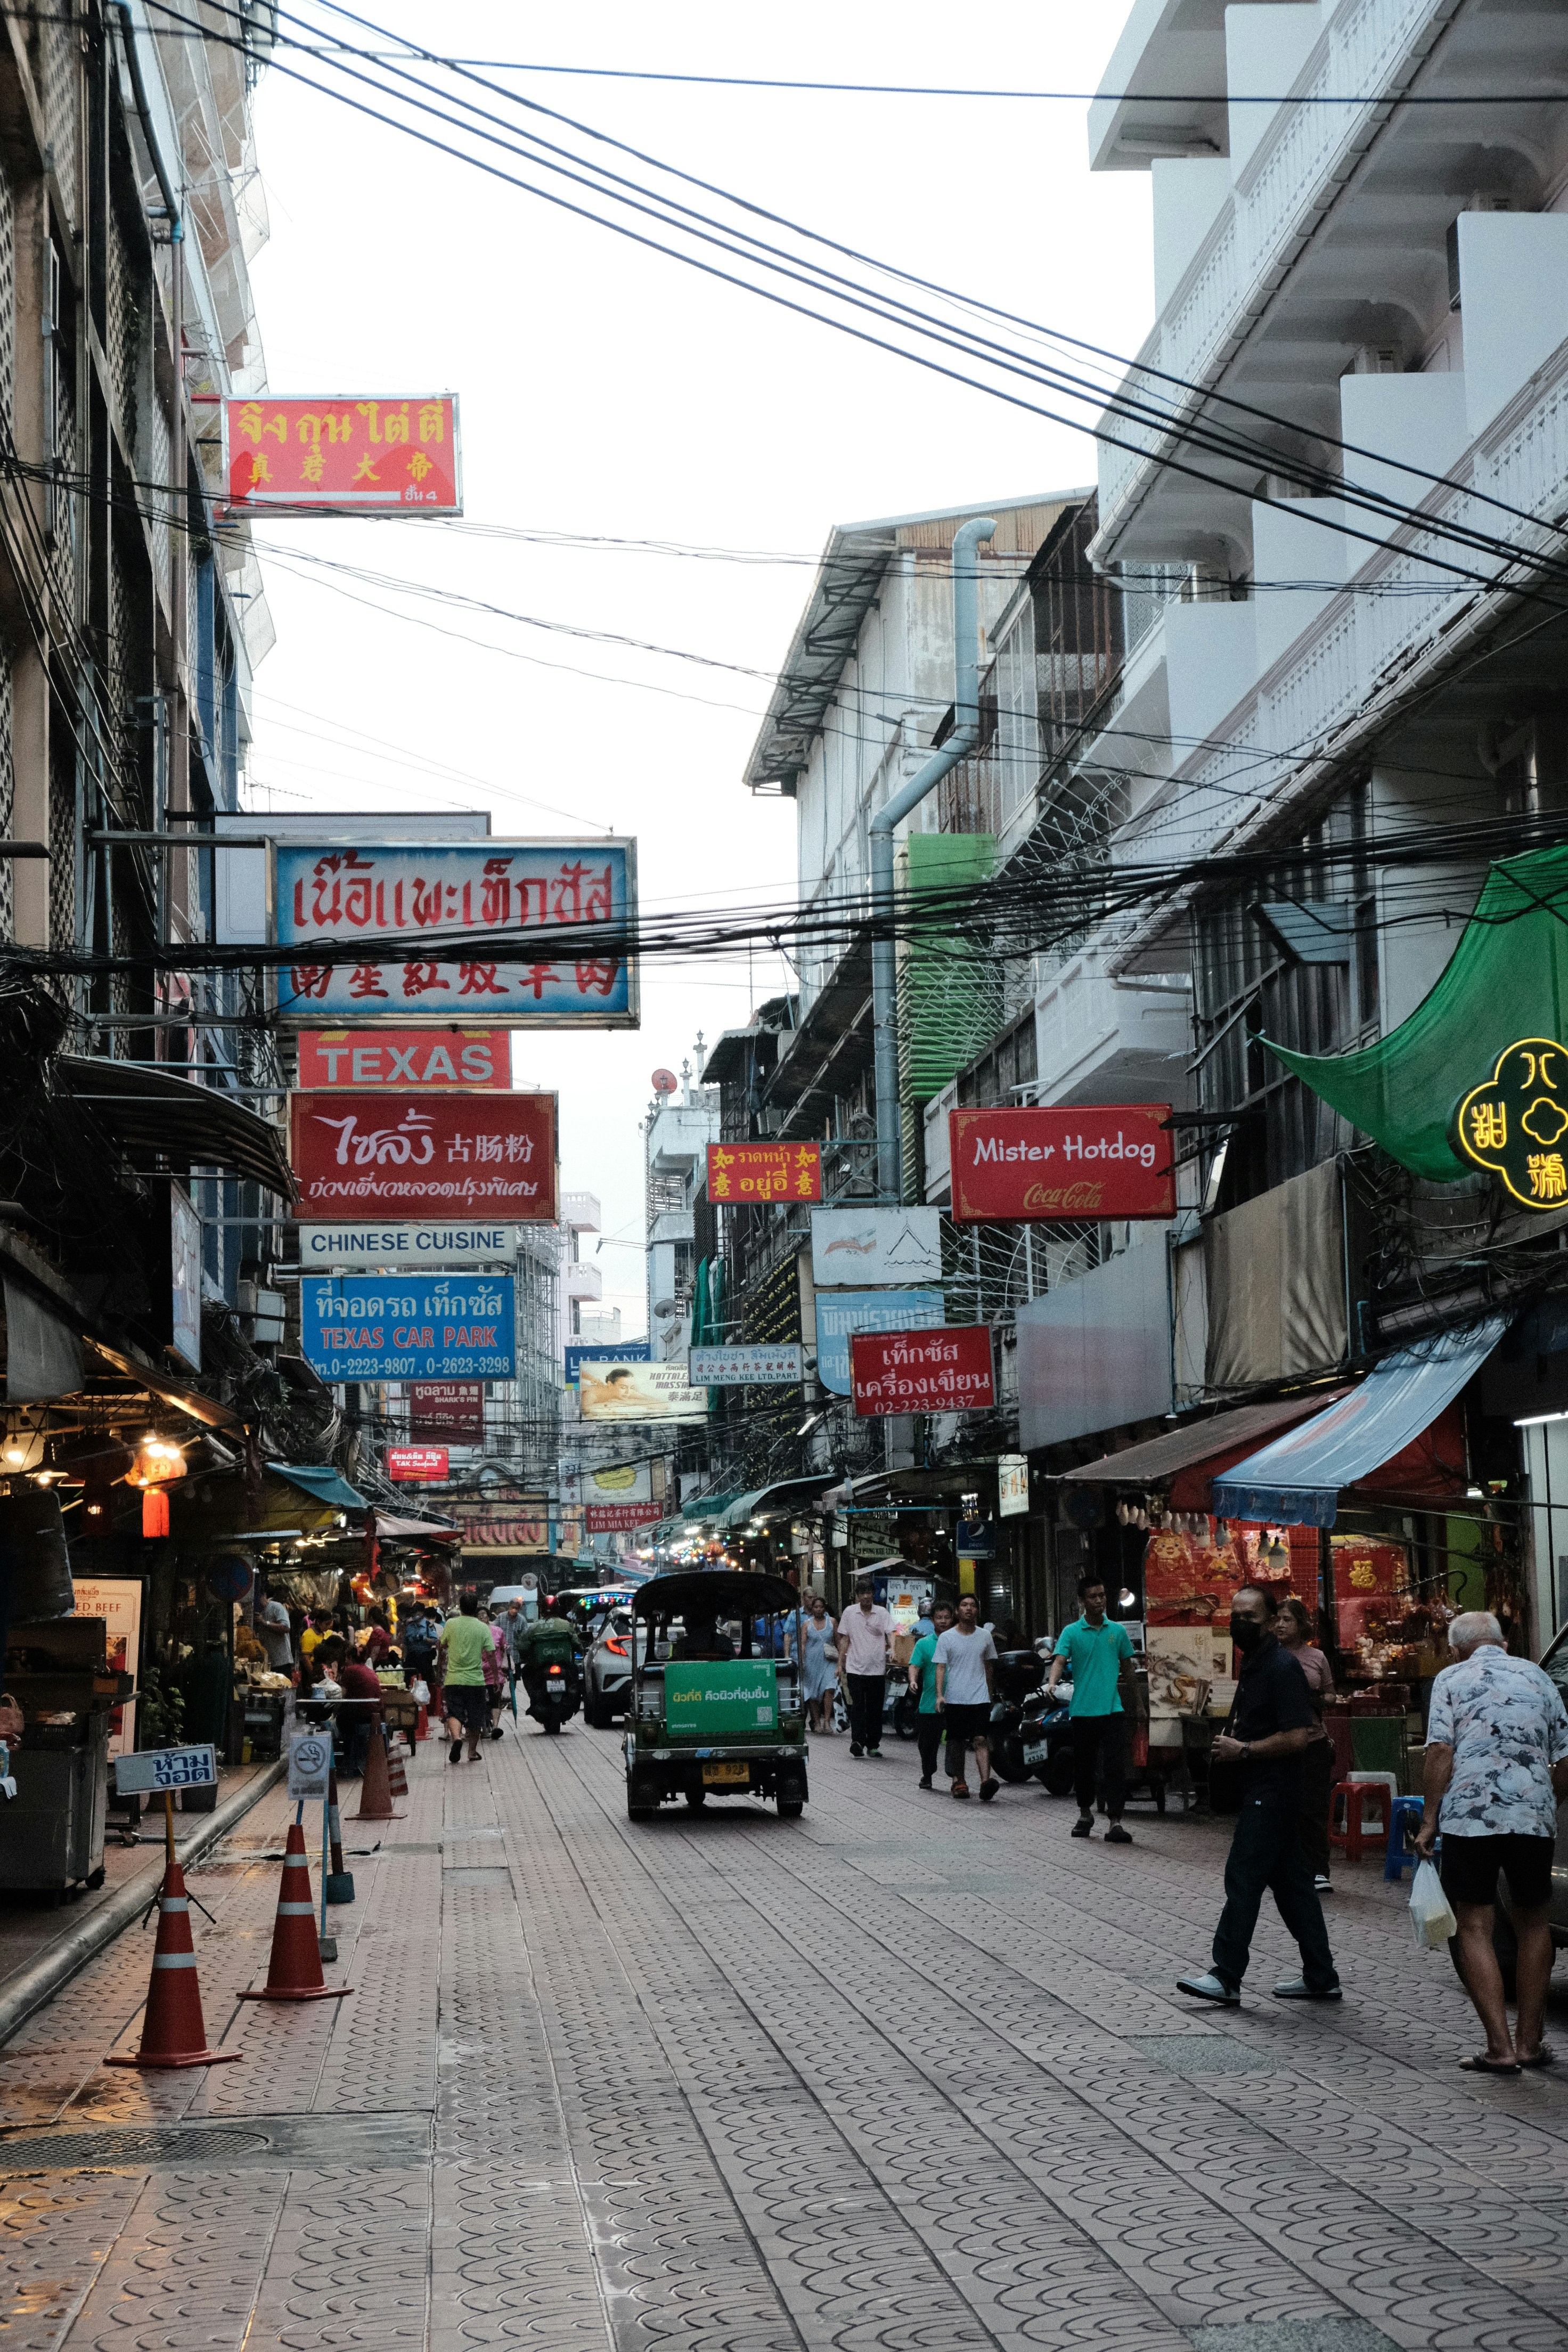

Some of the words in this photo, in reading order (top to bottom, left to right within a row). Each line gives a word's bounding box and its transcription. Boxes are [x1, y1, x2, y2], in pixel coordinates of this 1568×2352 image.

[316, 1044, 494, 1082] TEXAS
[444, 1133, 534, 1163] 古肠粉
[738, 1146, 791, 1163] ราดหน้า
[973, 1138, 1055, 1166] Mister
[1063, 1131, 1155, 1167] Hotdog
[311, 1232, 410, 1252] CHINESE
[416, 1230, 505, 1250] CUISINE
[316, 1279, 417, 1318] ที่จอดรถ
[424, 1281, 503, 1317] เท็กซัส
[320, 1327, 384, 1349] TEXAS
[393, 1326, 435, 1348] CAR
[444, 1326, 498, 1347] PARK
[883, 1338, 959, 1366] เท็กซัส
[427, 1356, 510, 1374] 0-2623-3298
[856, 1368, 990, 1398] เครื่องเขียน
[875, 1395, 975, 1414] 02-223-9437
[412, 1460, 438, 1469] Seafood
[591, 1521, 605, 1530] LIM
[608, 1520, 623, 1529] MIA
[96, 1603, 122, 1612] BEEF
[153, 1752, 209, 1772] ห้าม
[154, 1767, 210, 1785] จอด
